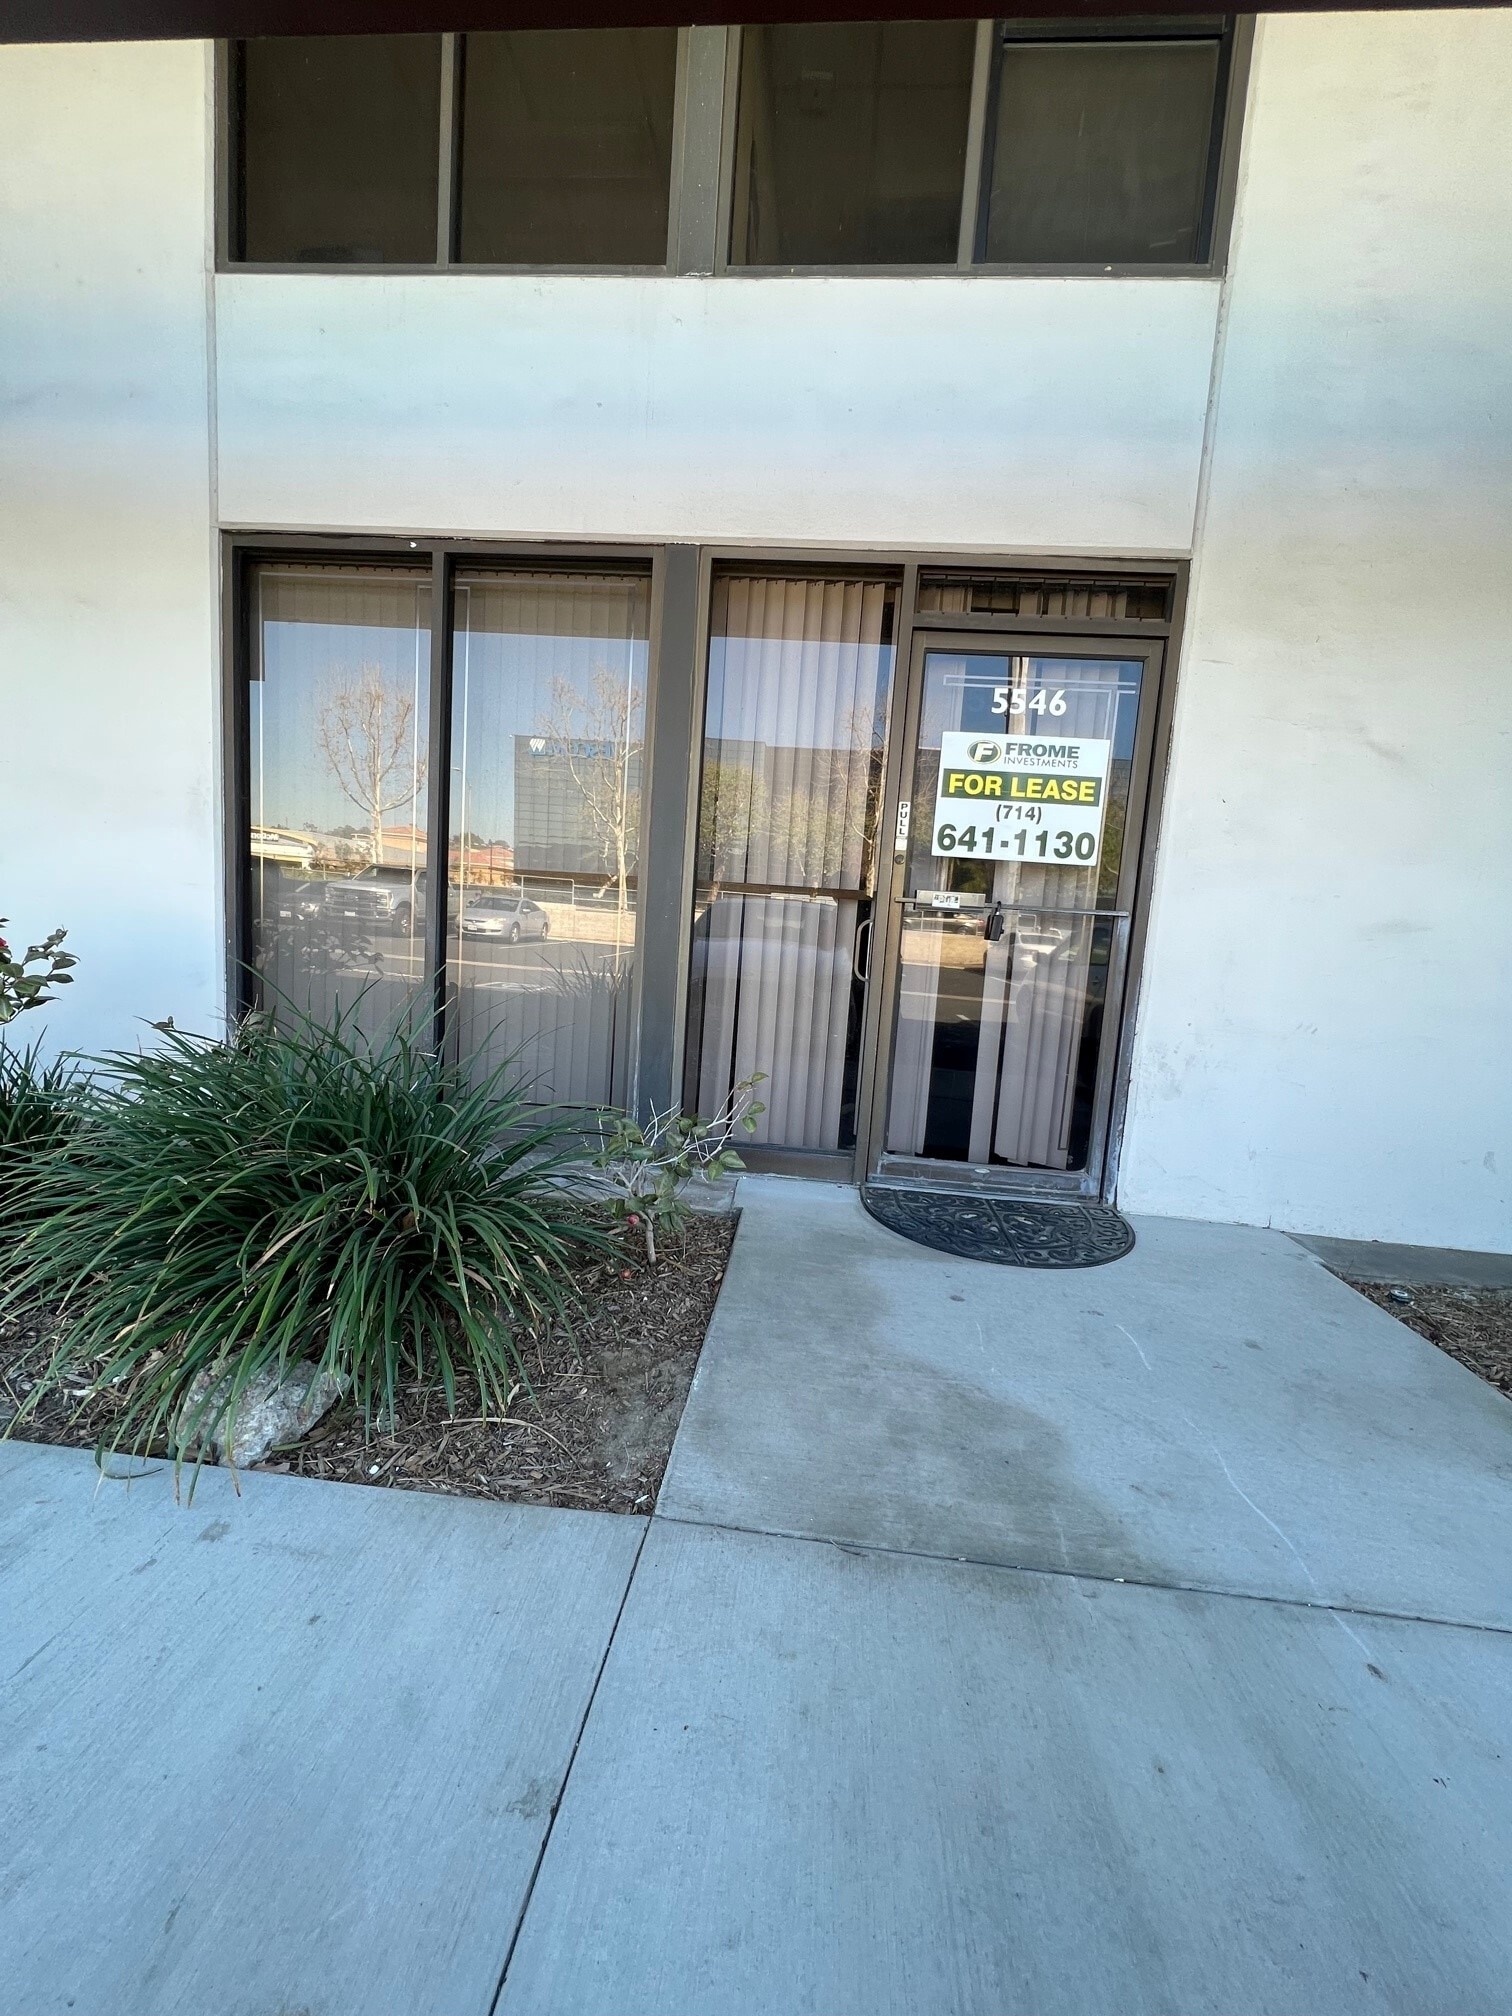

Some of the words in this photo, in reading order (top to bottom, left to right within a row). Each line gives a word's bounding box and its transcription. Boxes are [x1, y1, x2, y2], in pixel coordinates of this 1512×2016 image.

[991, 688, 1067, 716] 5546
[1003, 757, 1078, 769] INVESTMENTS
[1005, 742, 1081, 759] FROME
[948, 773, 1003, 796] FOR
[1010, 777, 1096, 802] LEASE
[899, 803, 908, 835] PULL
[996, 804, 1042, 824] (714)
[937, 824, 1096, 861] 641-1130
